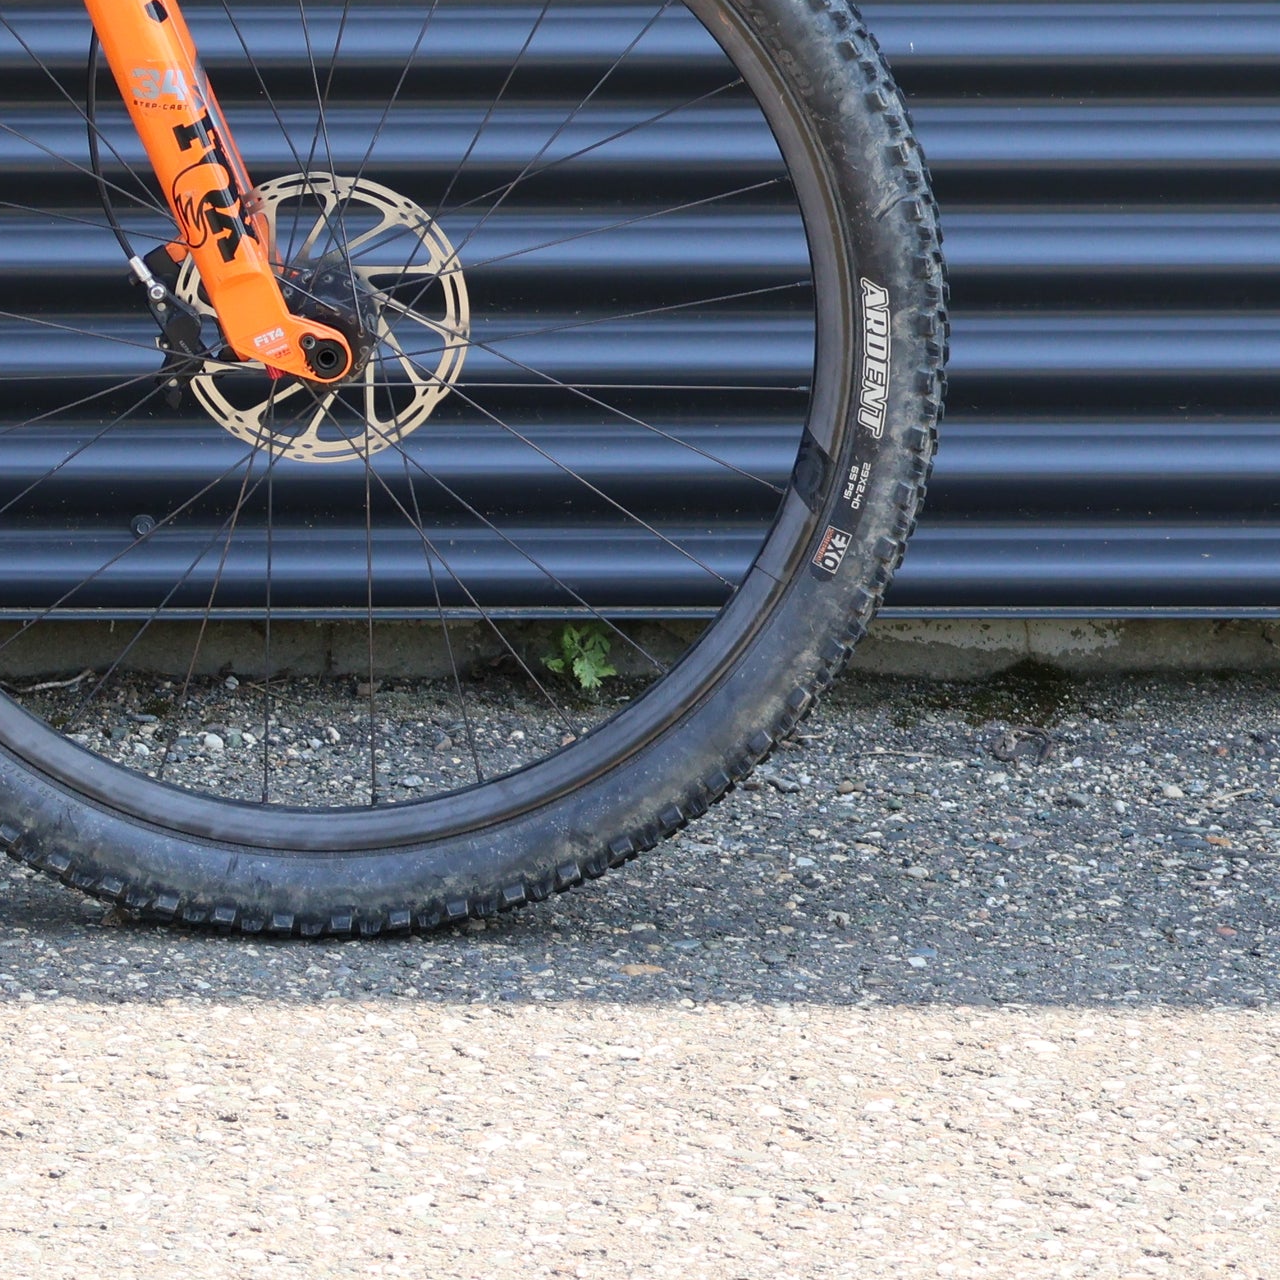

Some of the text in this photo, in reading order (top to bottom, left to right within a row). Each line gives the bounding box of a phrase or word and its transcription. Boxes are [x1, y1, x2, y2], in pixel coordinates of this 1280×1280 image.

[132, 68, 188, 101] 34
[133, 100, 190, 111] STEP-CAST
[172, 109, 261, 263] FOX
[857, 276, 891, 439] ARDENT
[843, 465, 860, 500] 65 PSI
[850, 462, 872, 510] 29X2.40
[820, 528, 852, 571] EXO
